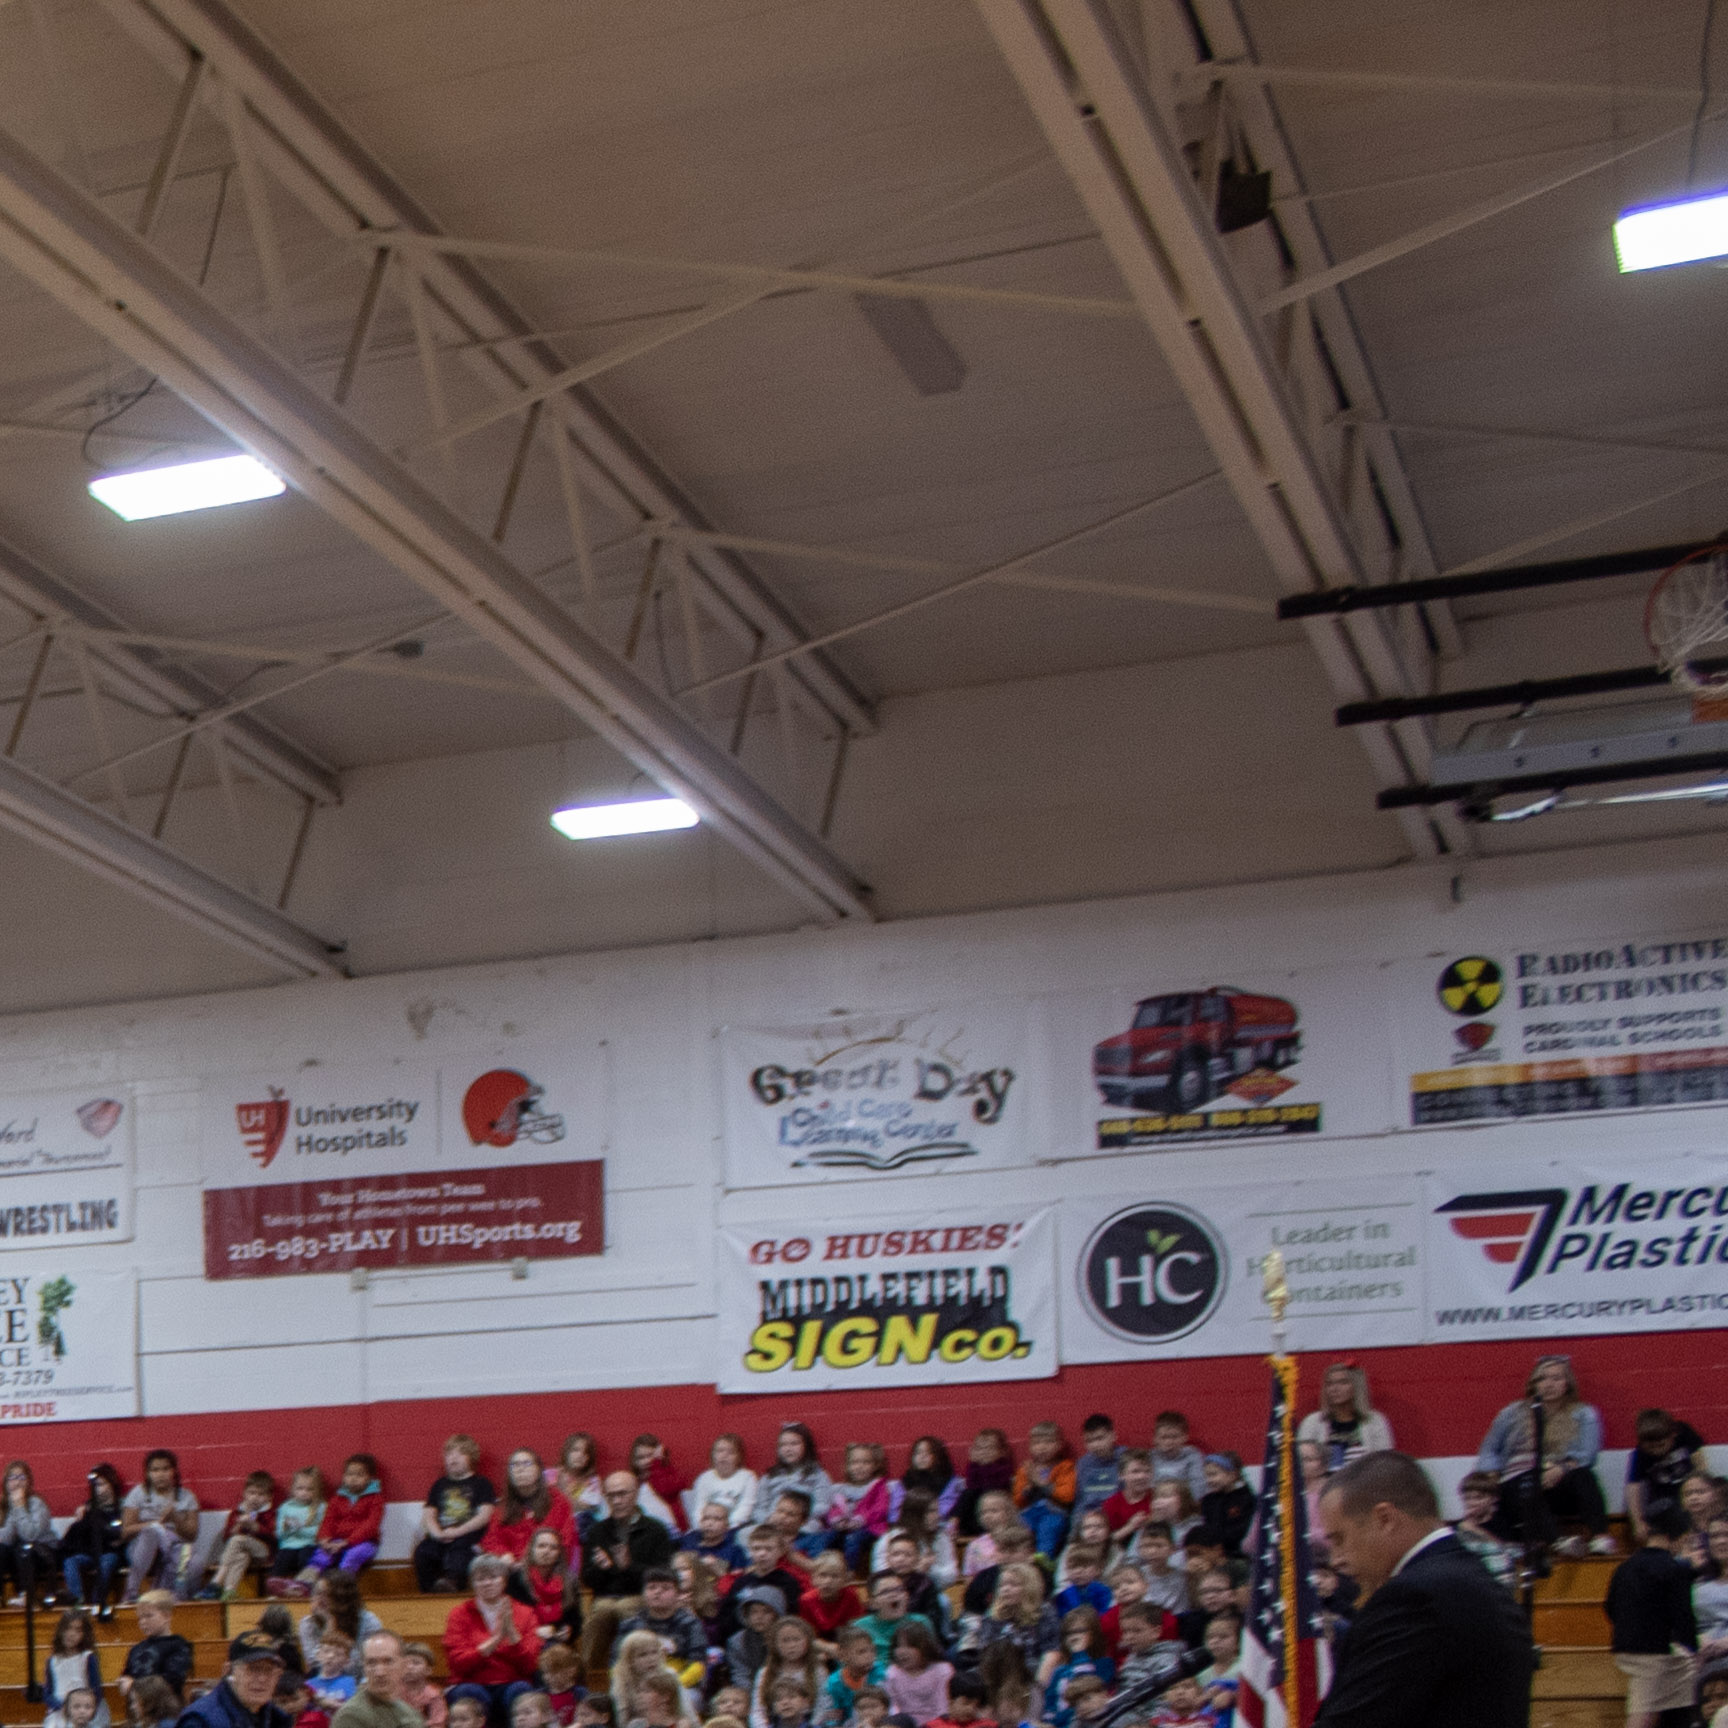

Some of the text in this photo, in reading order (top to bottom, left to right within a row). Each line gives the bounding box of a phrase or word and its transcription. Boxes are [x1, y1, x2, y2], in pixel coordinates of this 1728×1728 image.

[296, 1099, 420, 1127] University
[296, 1125, 408, 1157] Hospitals
[229, 1221, 582, 1261] 216-983-PLAY UHSports.org
[749, 1222, 1024, 1265] GO HUSKIES!
[1270, 1220, 1391, 1246] Leader in
[1104, 1250, 1205, 1309] HC
[1247, 1246, 1417, 1277] Hrticultural
[760, 1266, 1010, 1319] MIDDLEFIELD
[744, 1312, 940, 1373] SIGN
[0, 1401, 57, 1420] PRIDE
